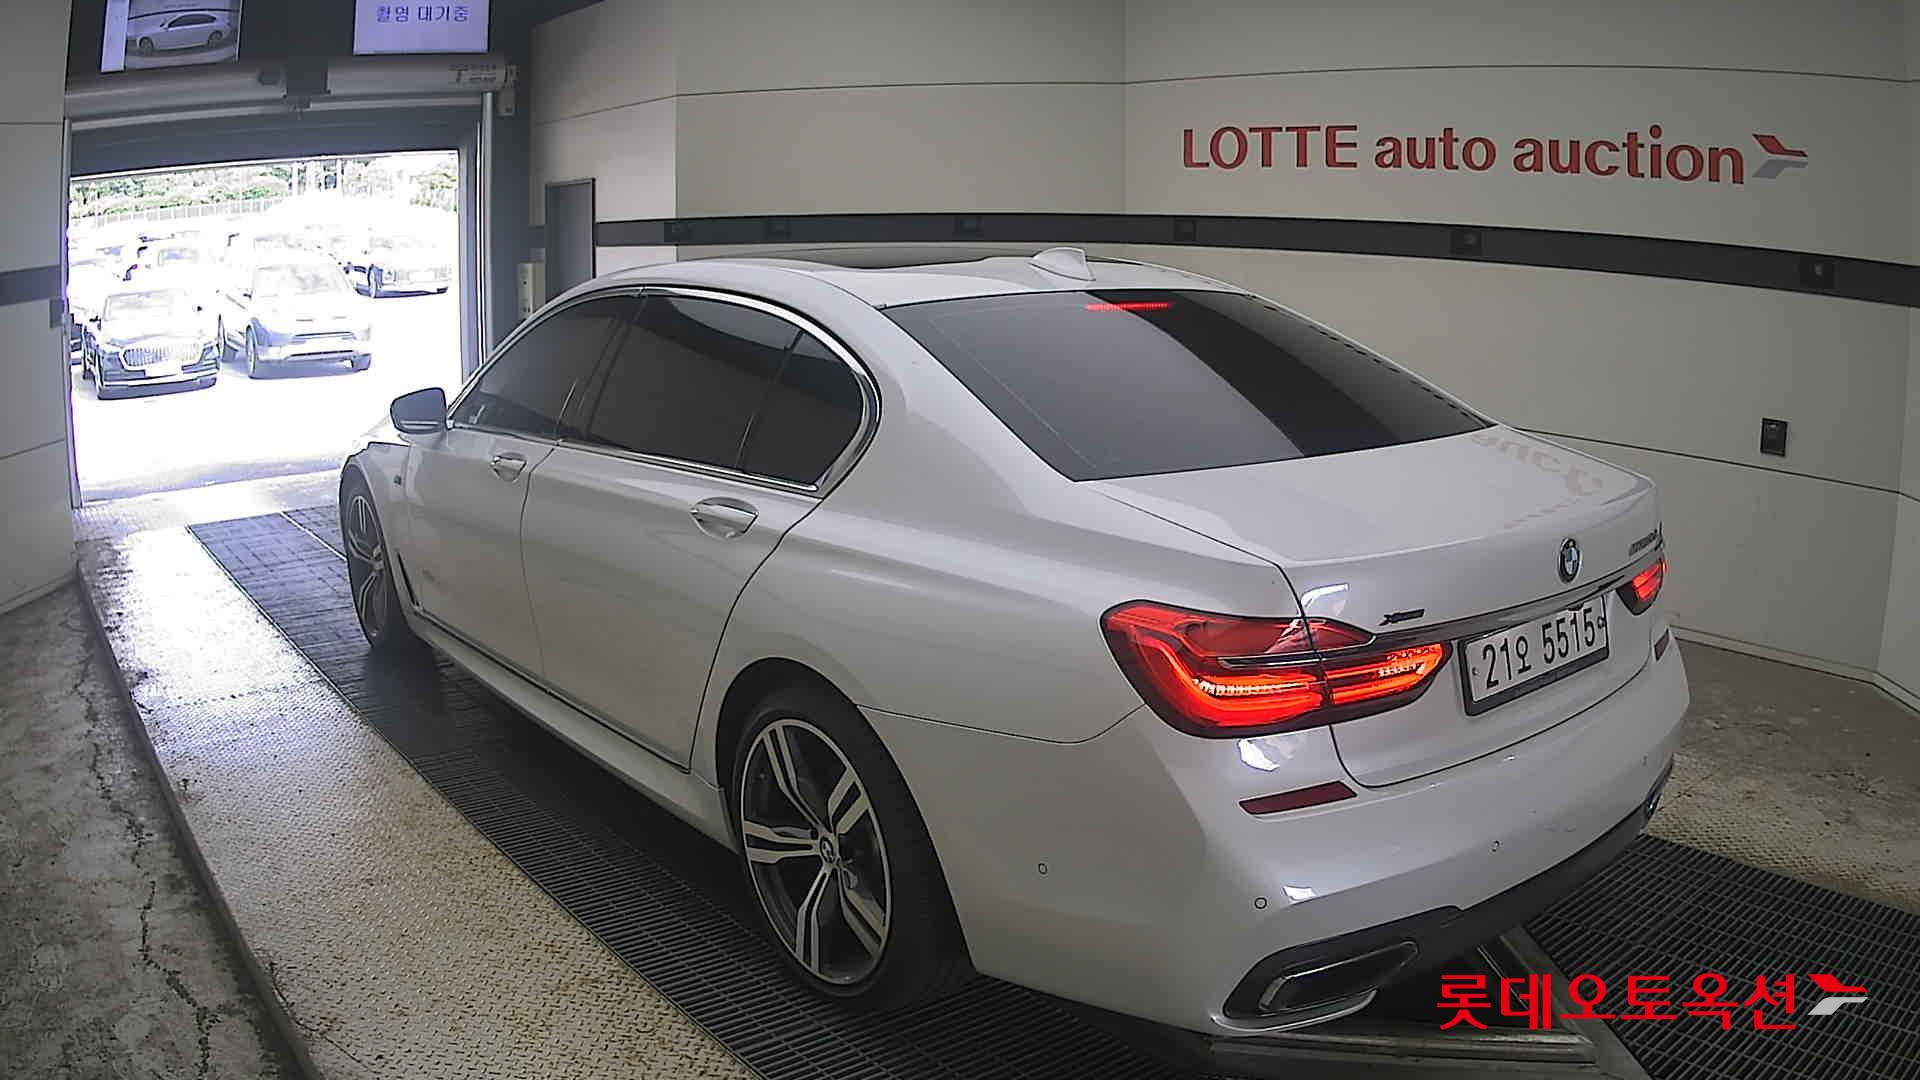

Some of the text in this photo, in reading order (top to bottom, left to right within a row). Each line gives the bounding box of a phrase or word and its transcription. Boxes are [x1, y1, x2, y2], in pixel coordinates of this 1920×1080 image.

[417, 5, 469, 22] 대기중
[1183, 124, 1746, 185] LOTTE auto auction
[1482, 607, 1596, 689] 21오 5515
